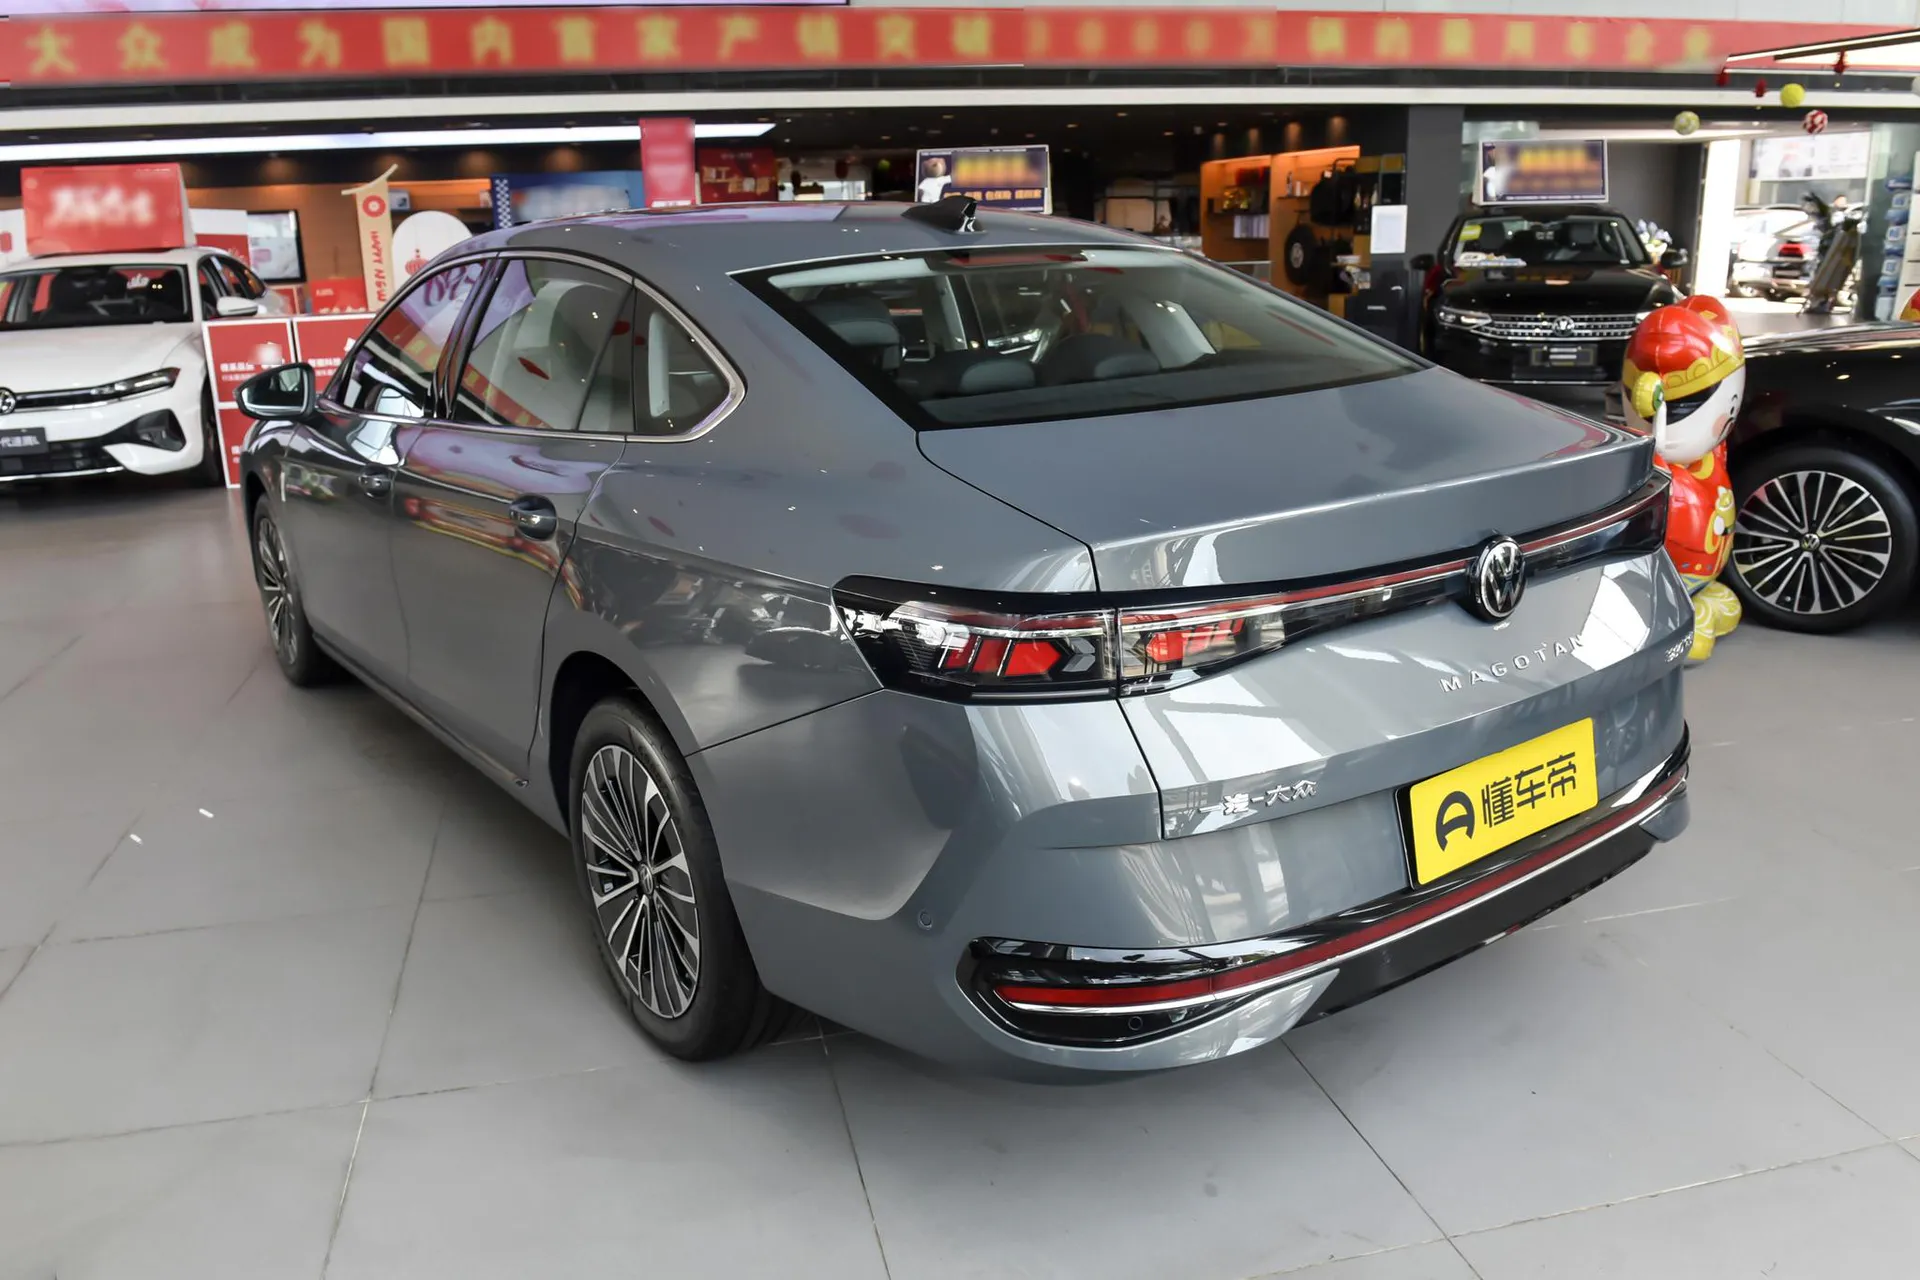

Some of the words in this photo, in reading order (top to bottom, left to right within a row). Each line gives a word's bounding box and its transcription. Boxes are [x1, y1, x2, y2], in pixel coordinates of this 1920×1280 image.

[1439, 633, 1586, 693] MAGOTAN
[1197, 779, 1318, 816] 一汽-大众
[1481, 751, 1577, 828] 懂车帝
